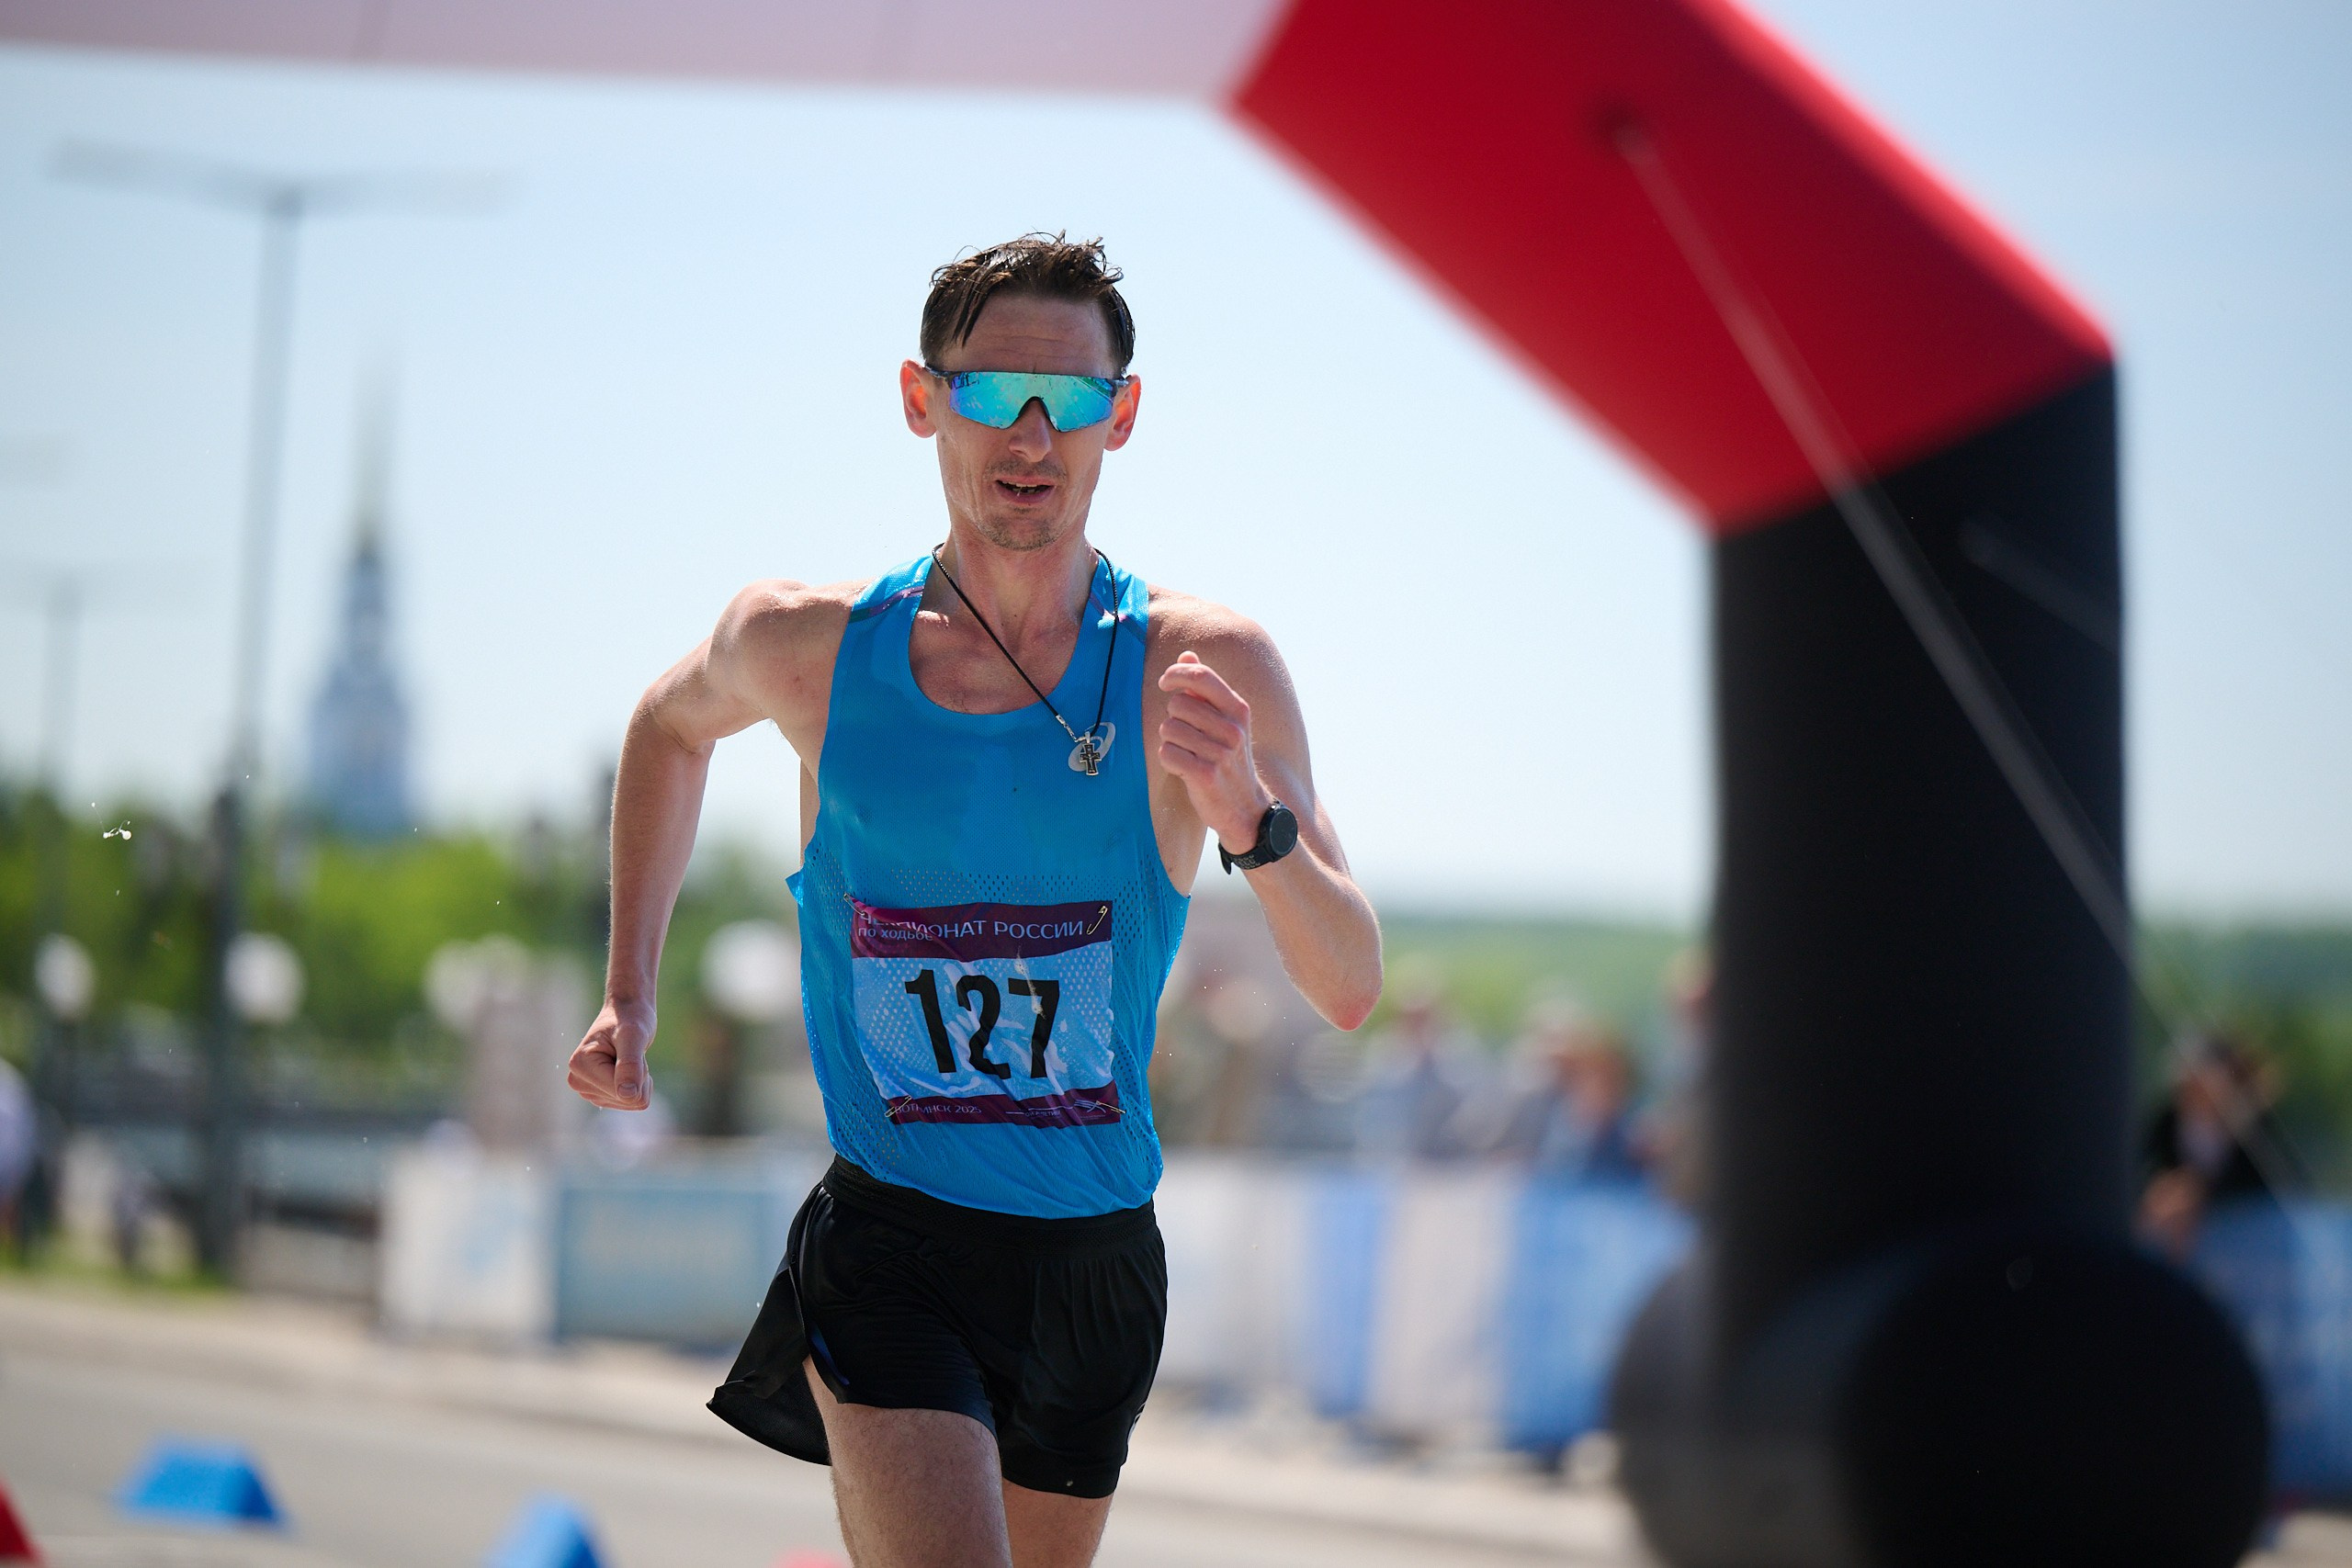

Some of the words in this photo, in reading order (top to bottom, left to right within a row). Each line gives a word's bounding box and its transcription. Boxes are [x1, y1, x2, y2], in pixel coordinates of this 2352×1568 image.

[994, 920, 1083, 939] РОССИИ
[904, 969, 1059, 1079] 127
[955, 1105, 982, 1113] 2025
